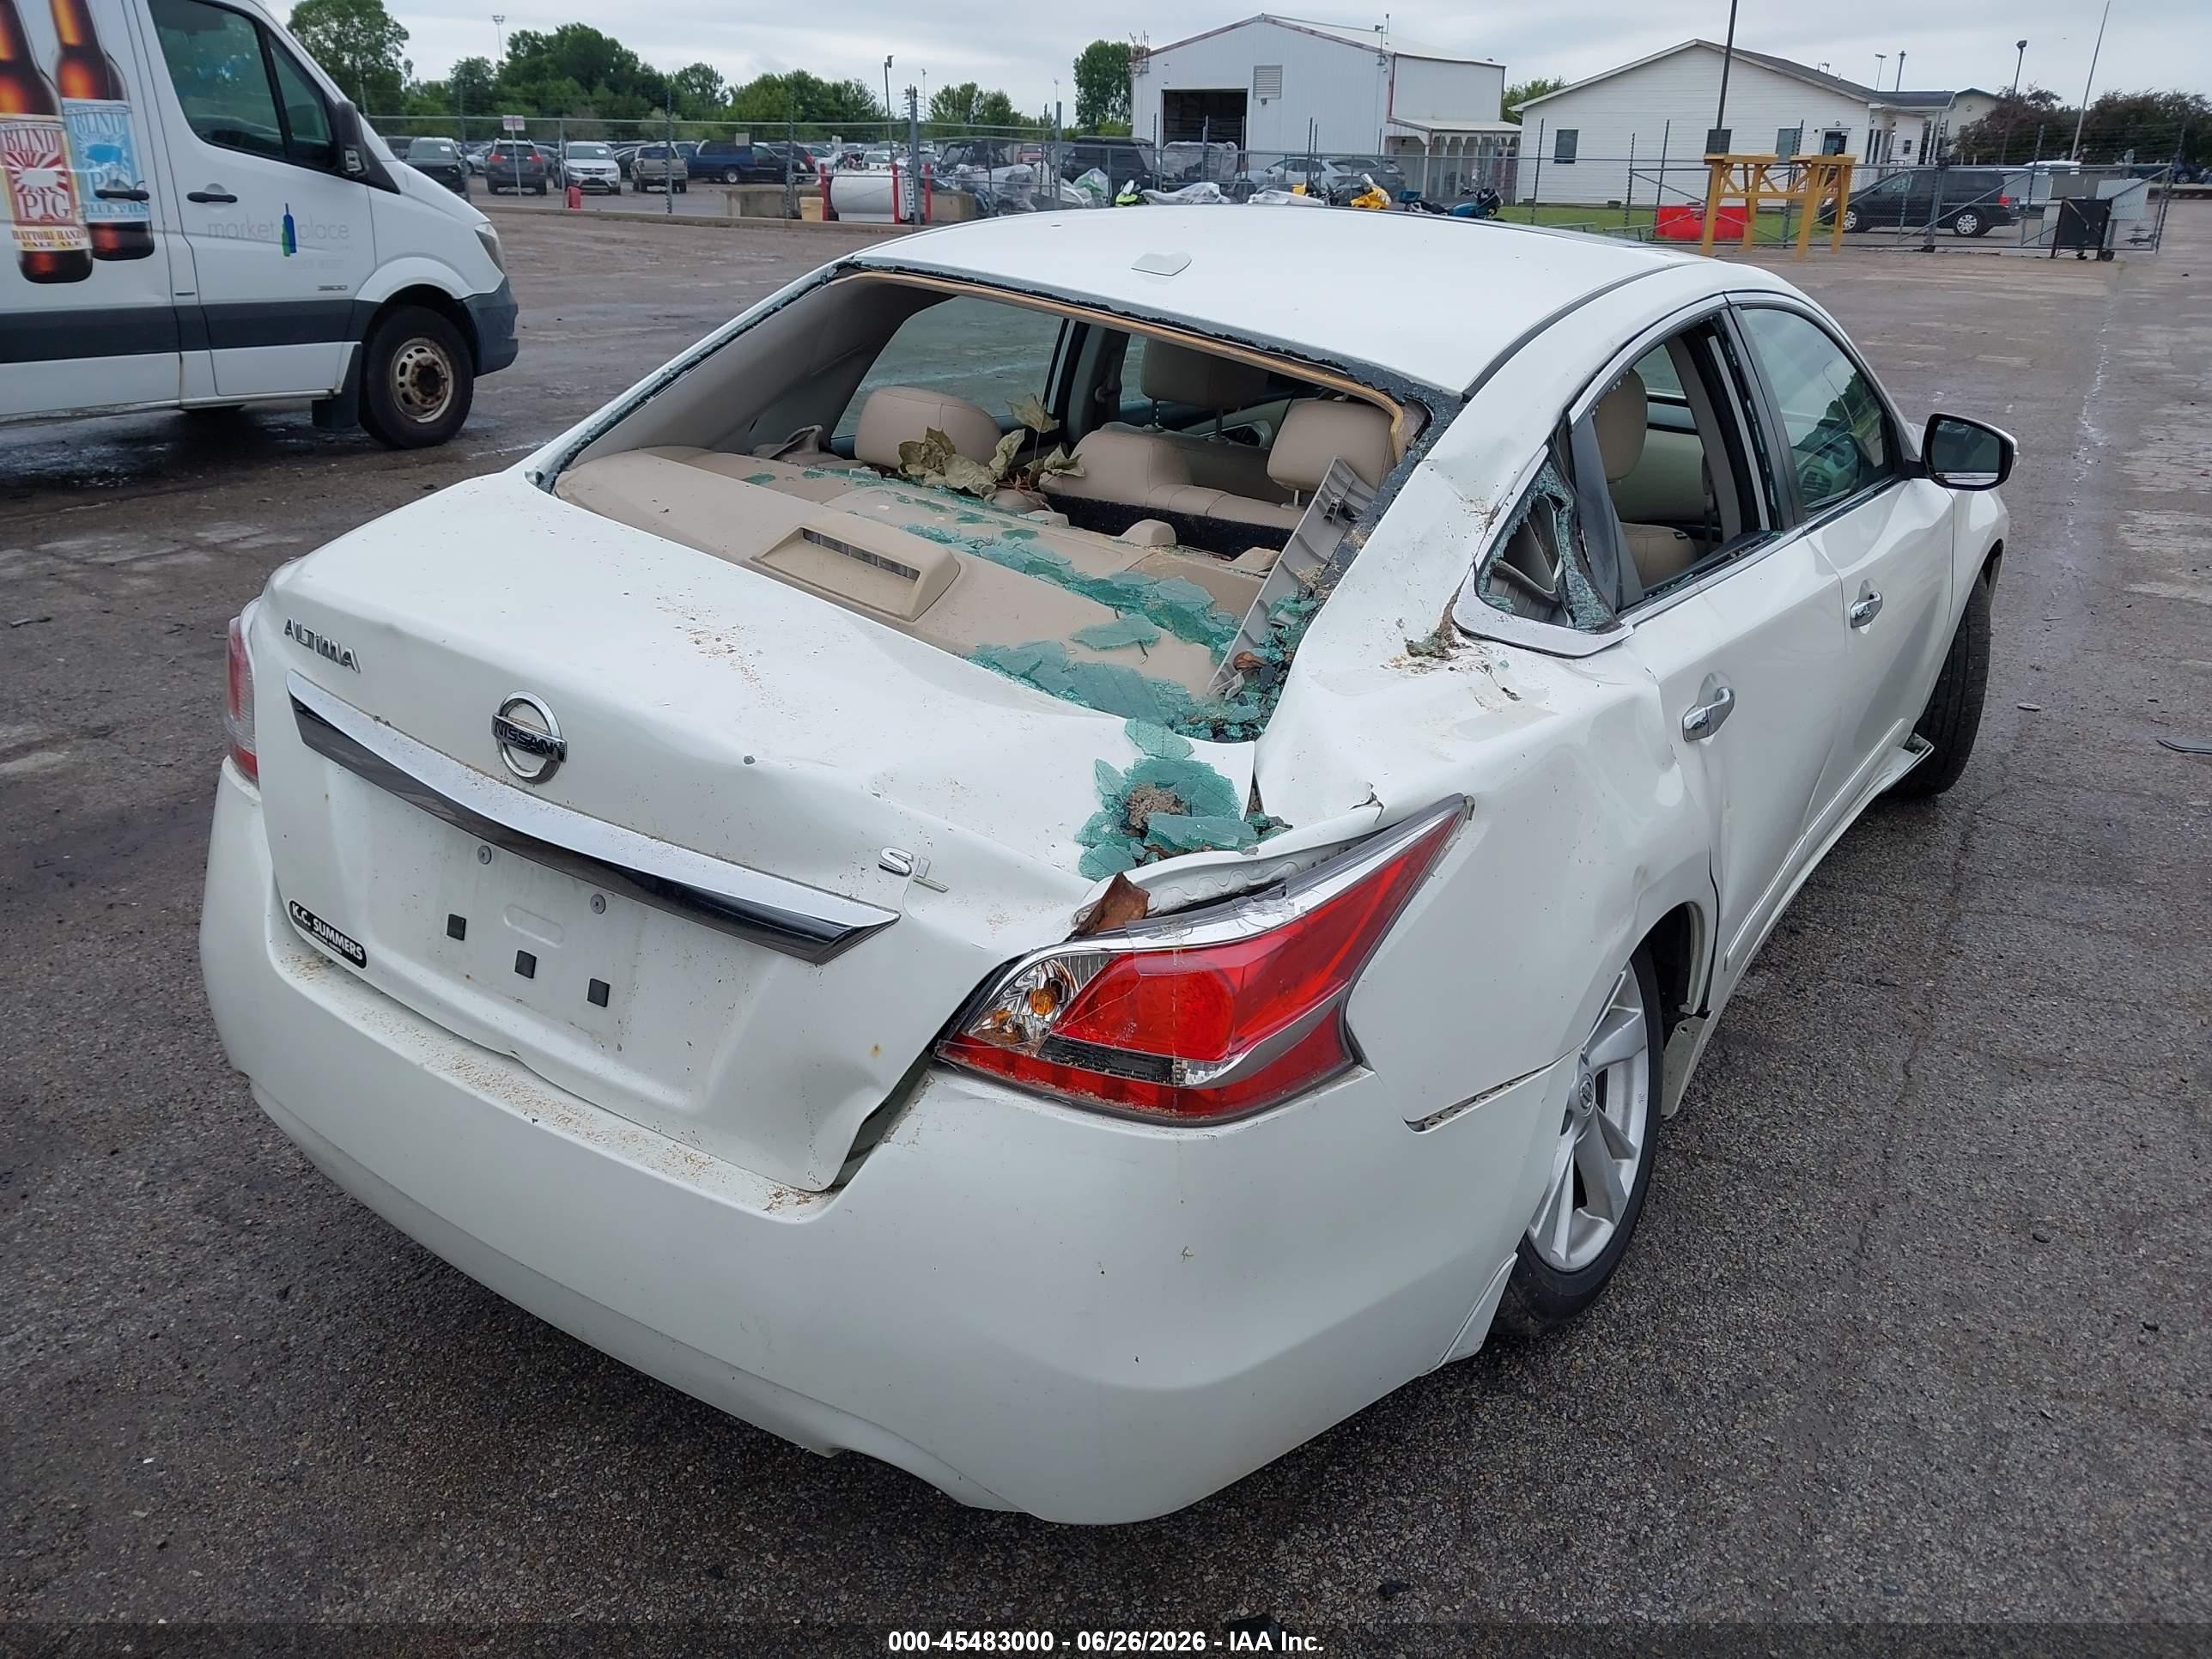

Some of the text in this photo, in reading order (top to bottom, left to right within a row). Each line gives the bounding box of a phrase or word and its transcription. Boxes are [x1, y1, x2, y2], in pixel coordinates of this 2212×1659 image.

[72, 112, 125, 134] BLIND
[4, 129, 58, 153] BLIND
[19, 192, 70, 219] PIG
[207, 213, 350, 243] market place
[495, 721, 556, 756] NISSAN
[878, 846, 950, 894] SL
[291, 902, 312, 927] K.C.
[312, 917, 363, 961] SUMMERS
